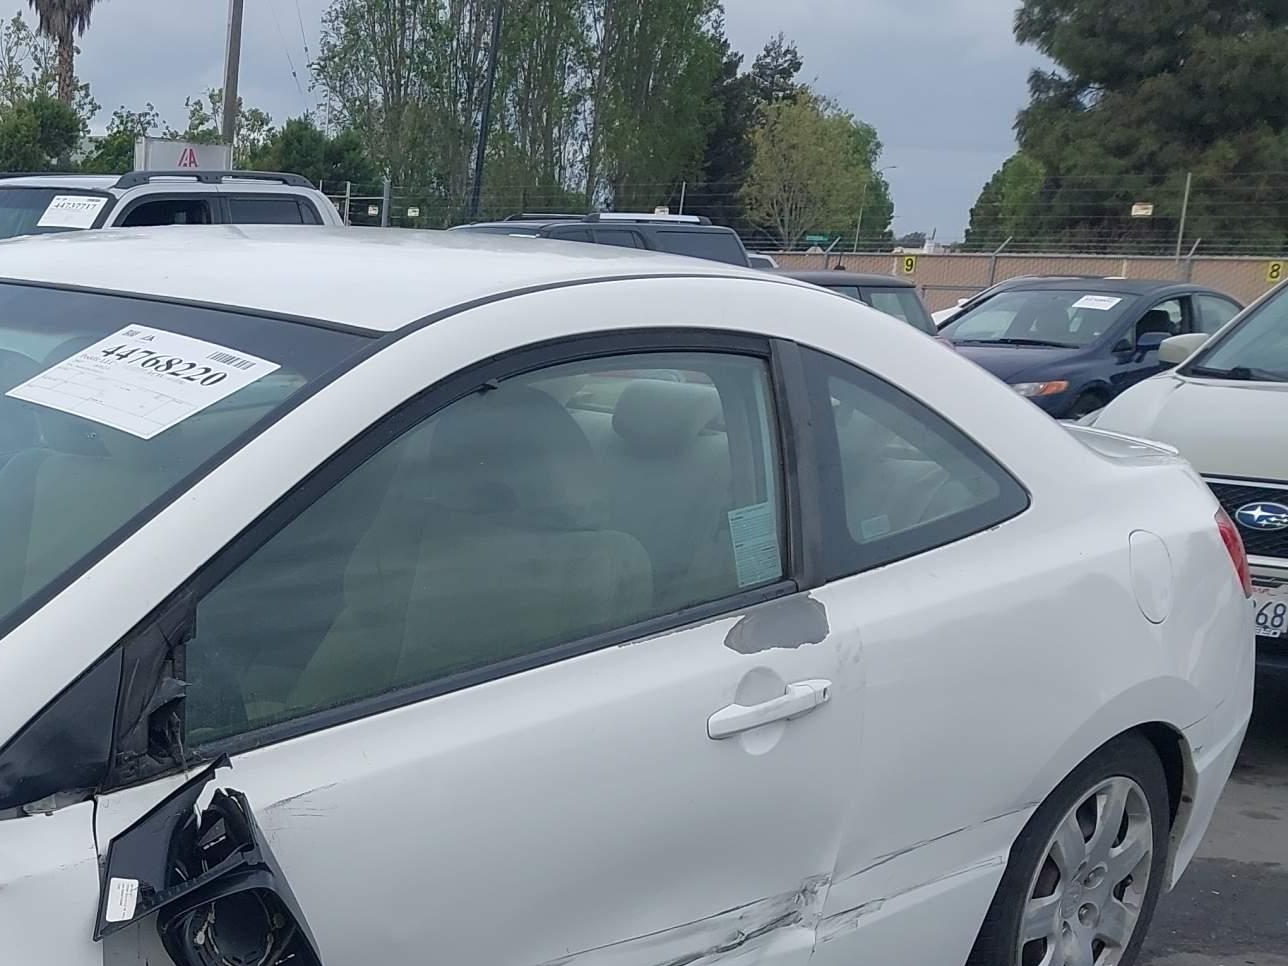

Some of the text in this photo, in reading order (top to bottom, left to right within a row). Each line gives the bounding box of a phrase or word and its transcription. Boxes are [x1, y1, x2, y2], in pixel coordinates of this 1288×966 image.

[905, 257, 914, 272] 9
[1269, 263, 1280, 278] 8
[102, 344, 228, 387] 44768220
[1253, 598, 1286, 627] 68
